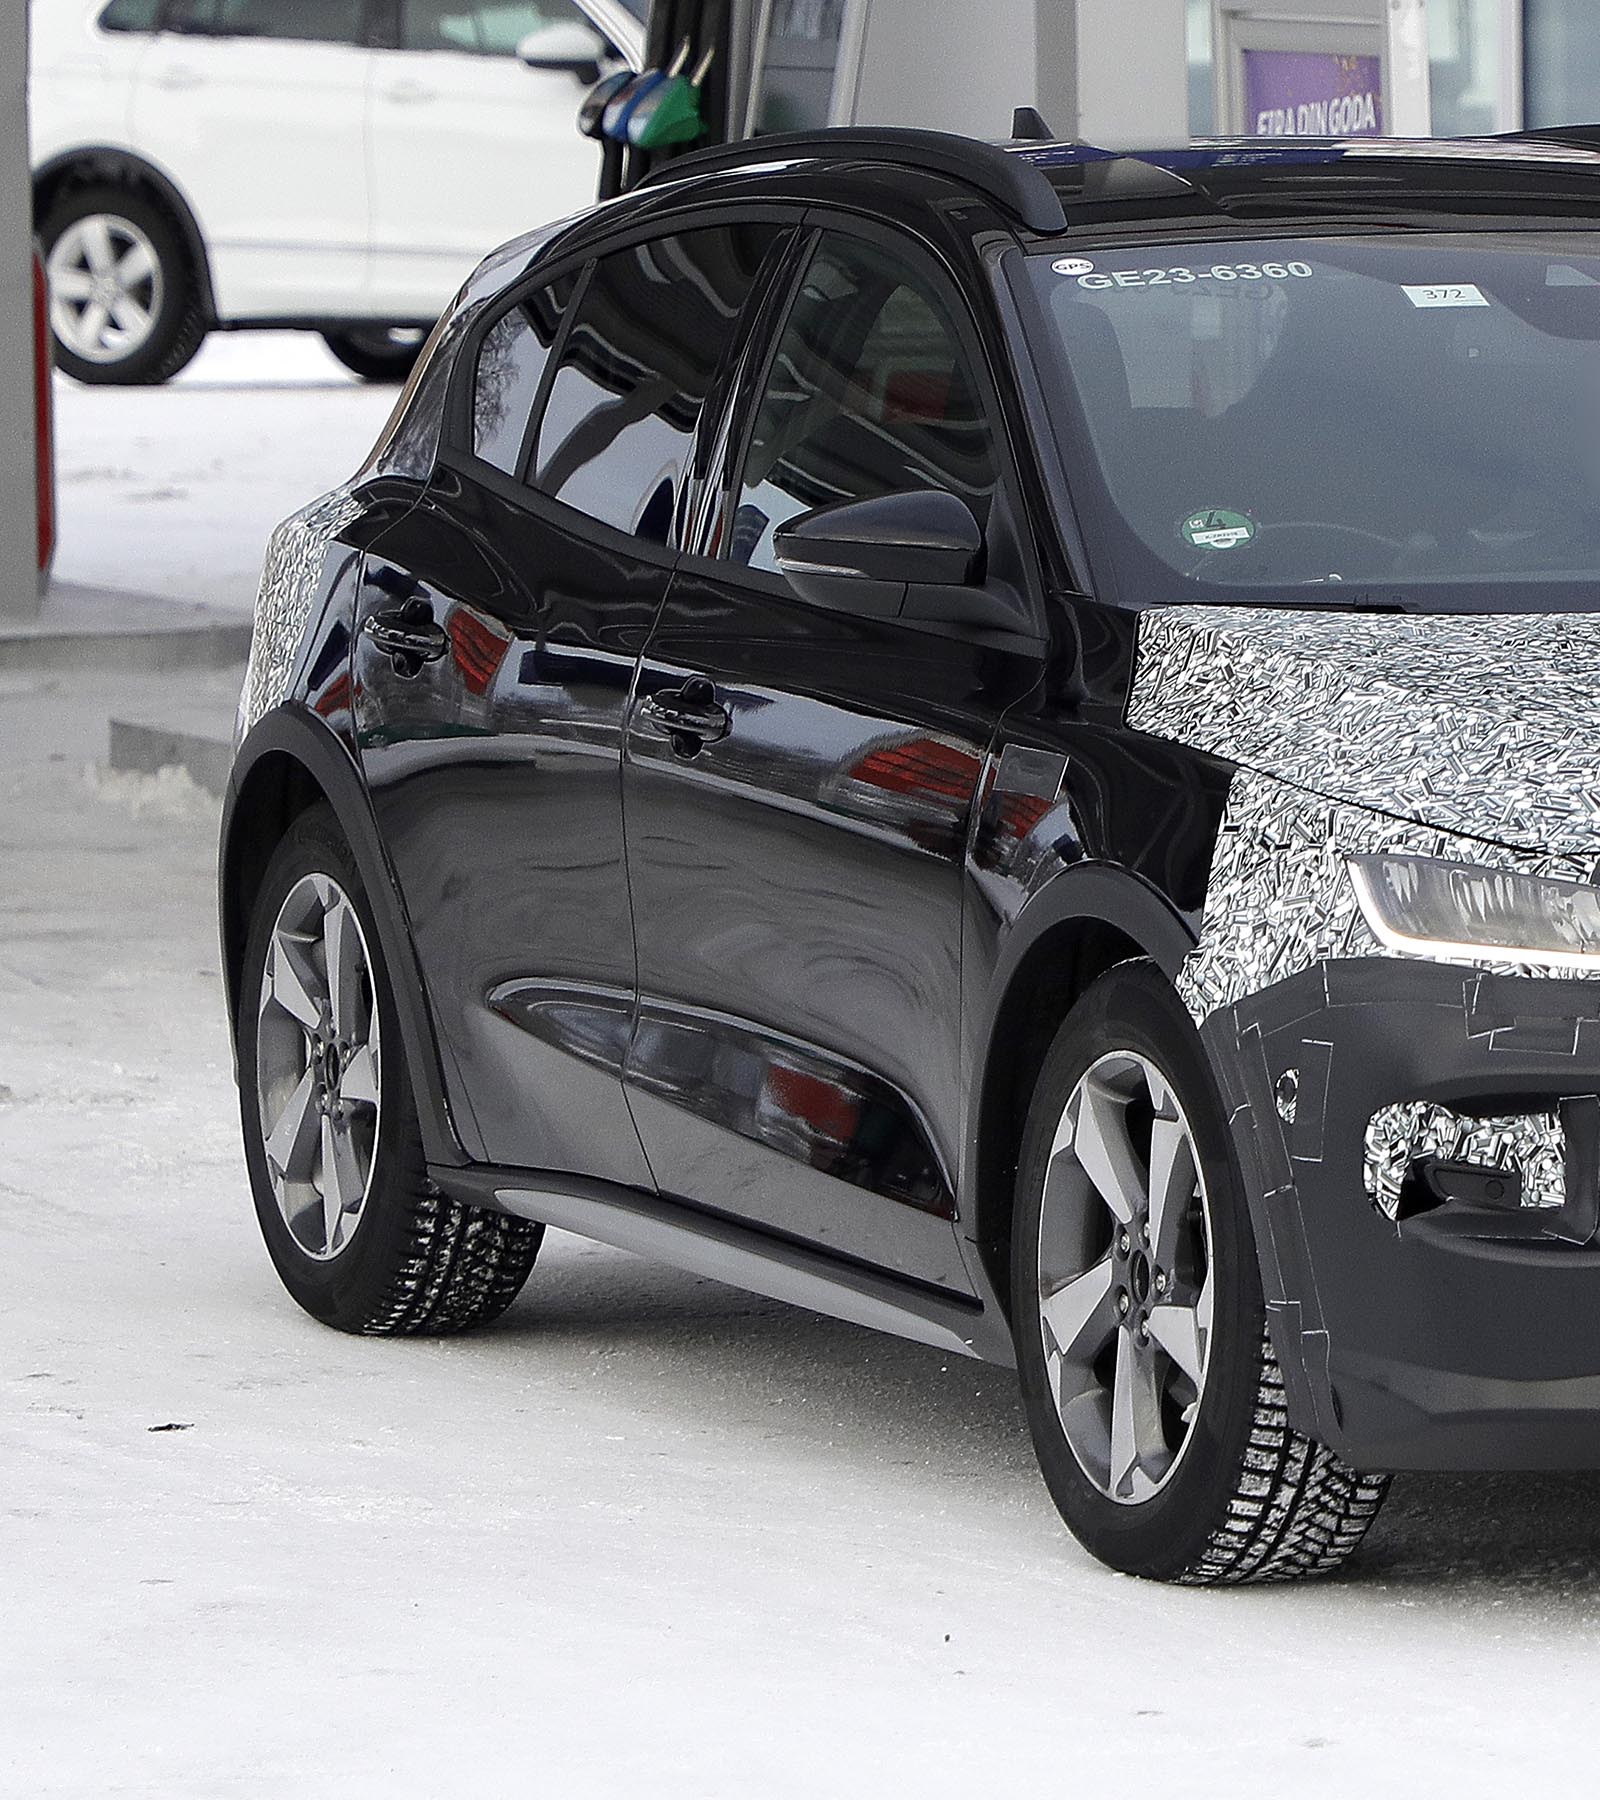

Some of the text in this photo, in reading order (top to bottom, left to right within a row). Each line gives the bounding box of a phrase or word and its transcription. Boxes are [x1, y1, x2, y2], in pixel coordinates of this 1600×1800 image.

[1329, 92, 1377, 135] GODA
[1054, 262, 1091, 271] GPS
[1077, 261, 1313, 289] GE23-6360
[1422, 288, 1466, 299] 372
